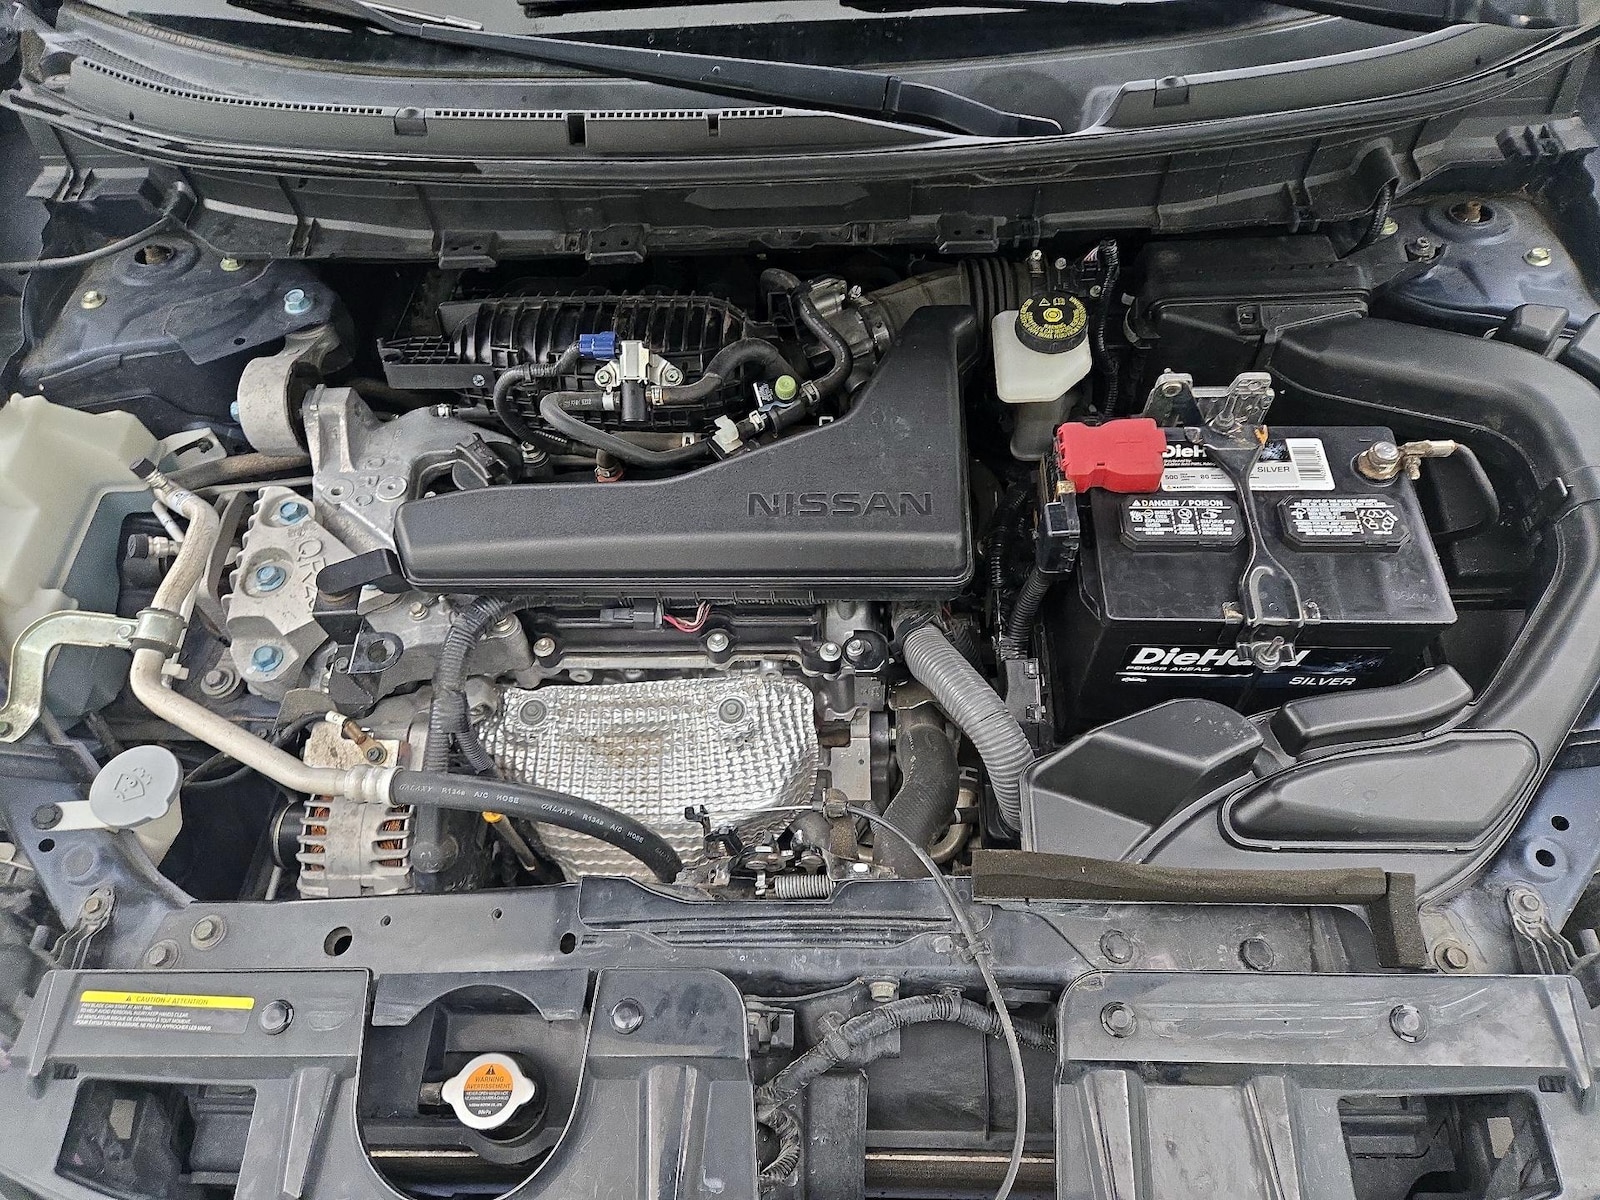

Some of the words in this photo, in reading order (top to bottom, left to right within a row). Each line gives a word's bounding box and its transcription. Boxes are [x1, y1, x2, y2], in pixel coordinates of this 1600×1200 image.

[748, 492, 933, 517] NISSAN
[1289, 677, 1356, 686] SILVER
[399, 784, 433, 792] GALAXY
[474, 791, 489, 799] A/C
[496, 794, 520, 804] HOSE
[541, 804, 576, 816] GALAXY
[582, 814, 604, 826] R134a
[610, 823, 623, 834] A/C
[627, 830, 644, 844] HOSE
